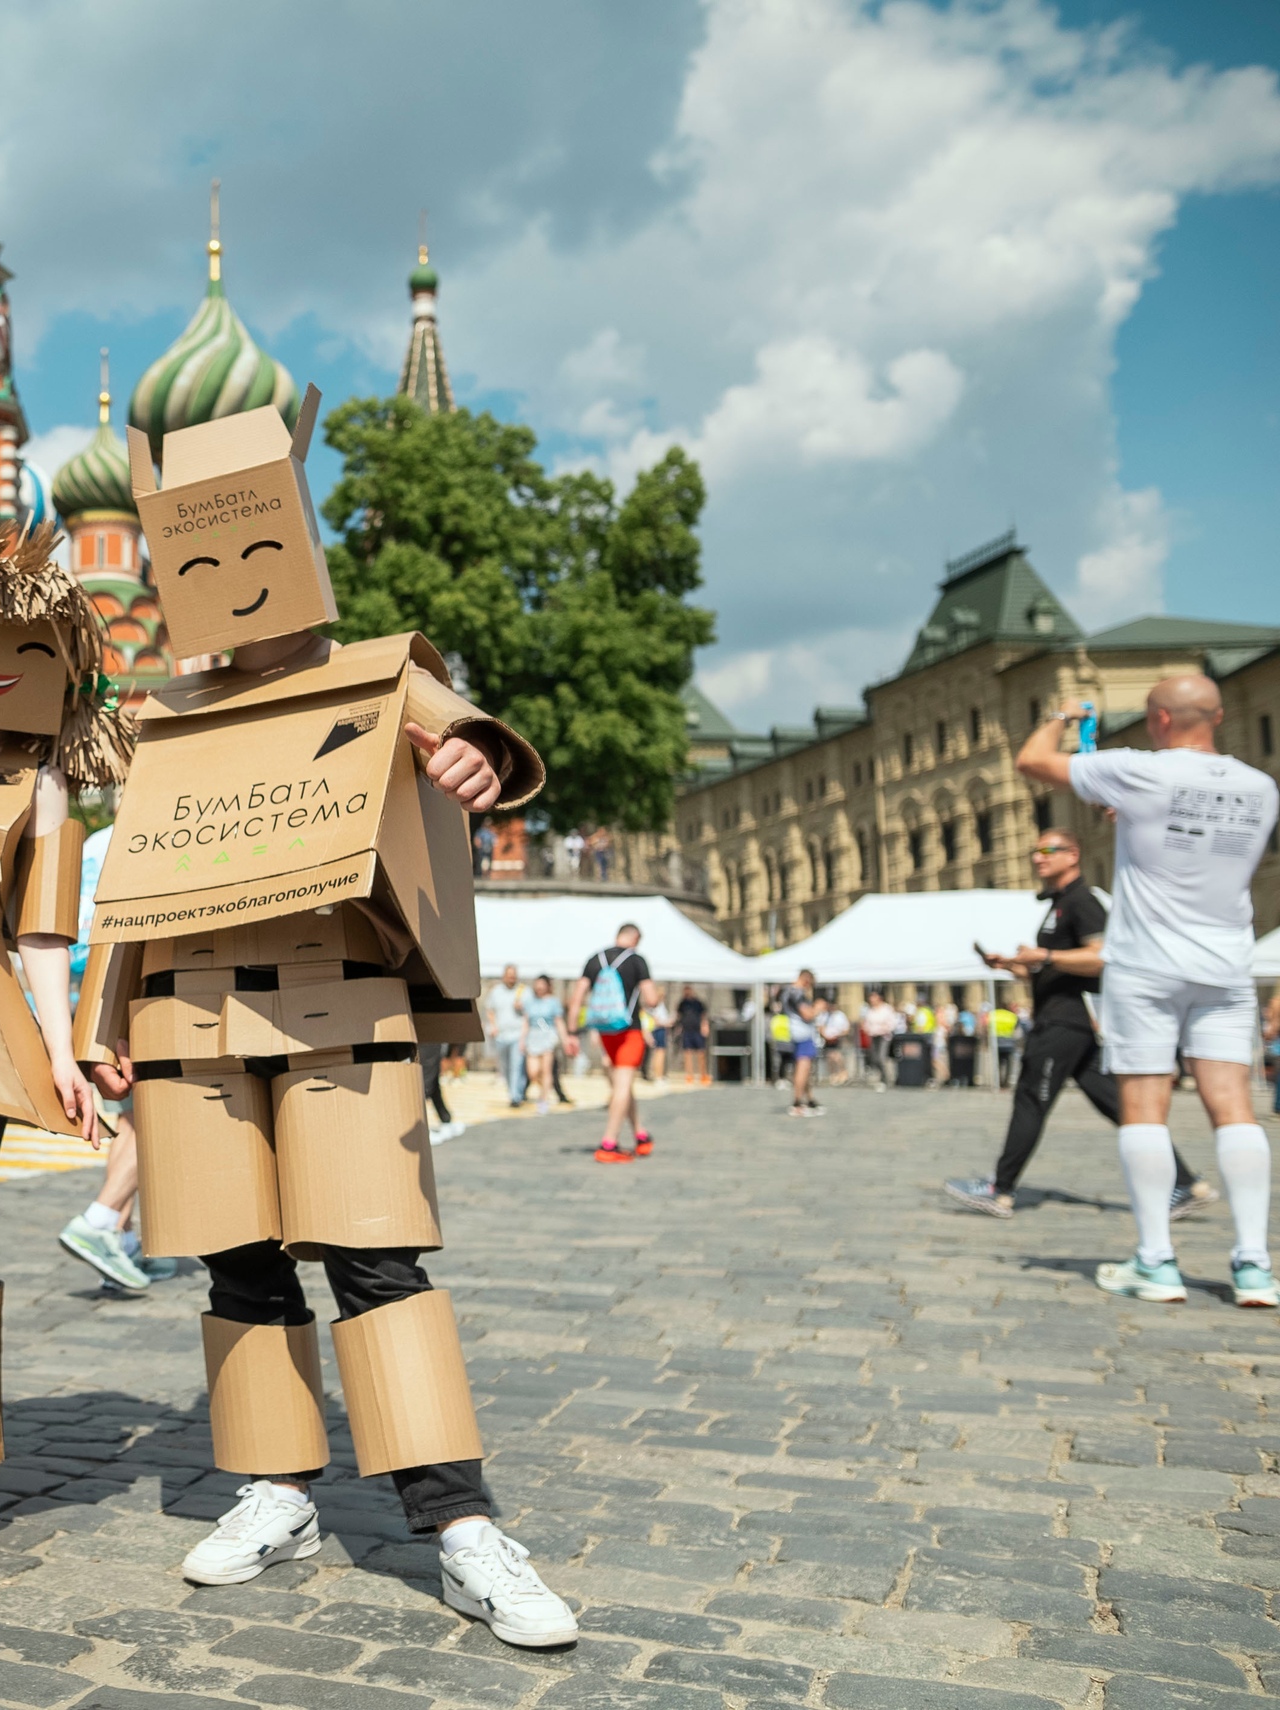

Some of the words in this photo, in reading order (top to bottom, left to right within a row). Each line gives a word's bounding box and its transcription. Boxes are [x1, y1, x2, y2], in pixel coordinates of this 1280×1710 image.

[162, 497, 282, 538] экосистема
[176, 489, 258, 519] БумБатл
[127, 791, 369, 855] экосистема
[173, 777, 330, 824] БумБатл
[101, 870, 359, 930] #нацпроектэкоблагополучие
